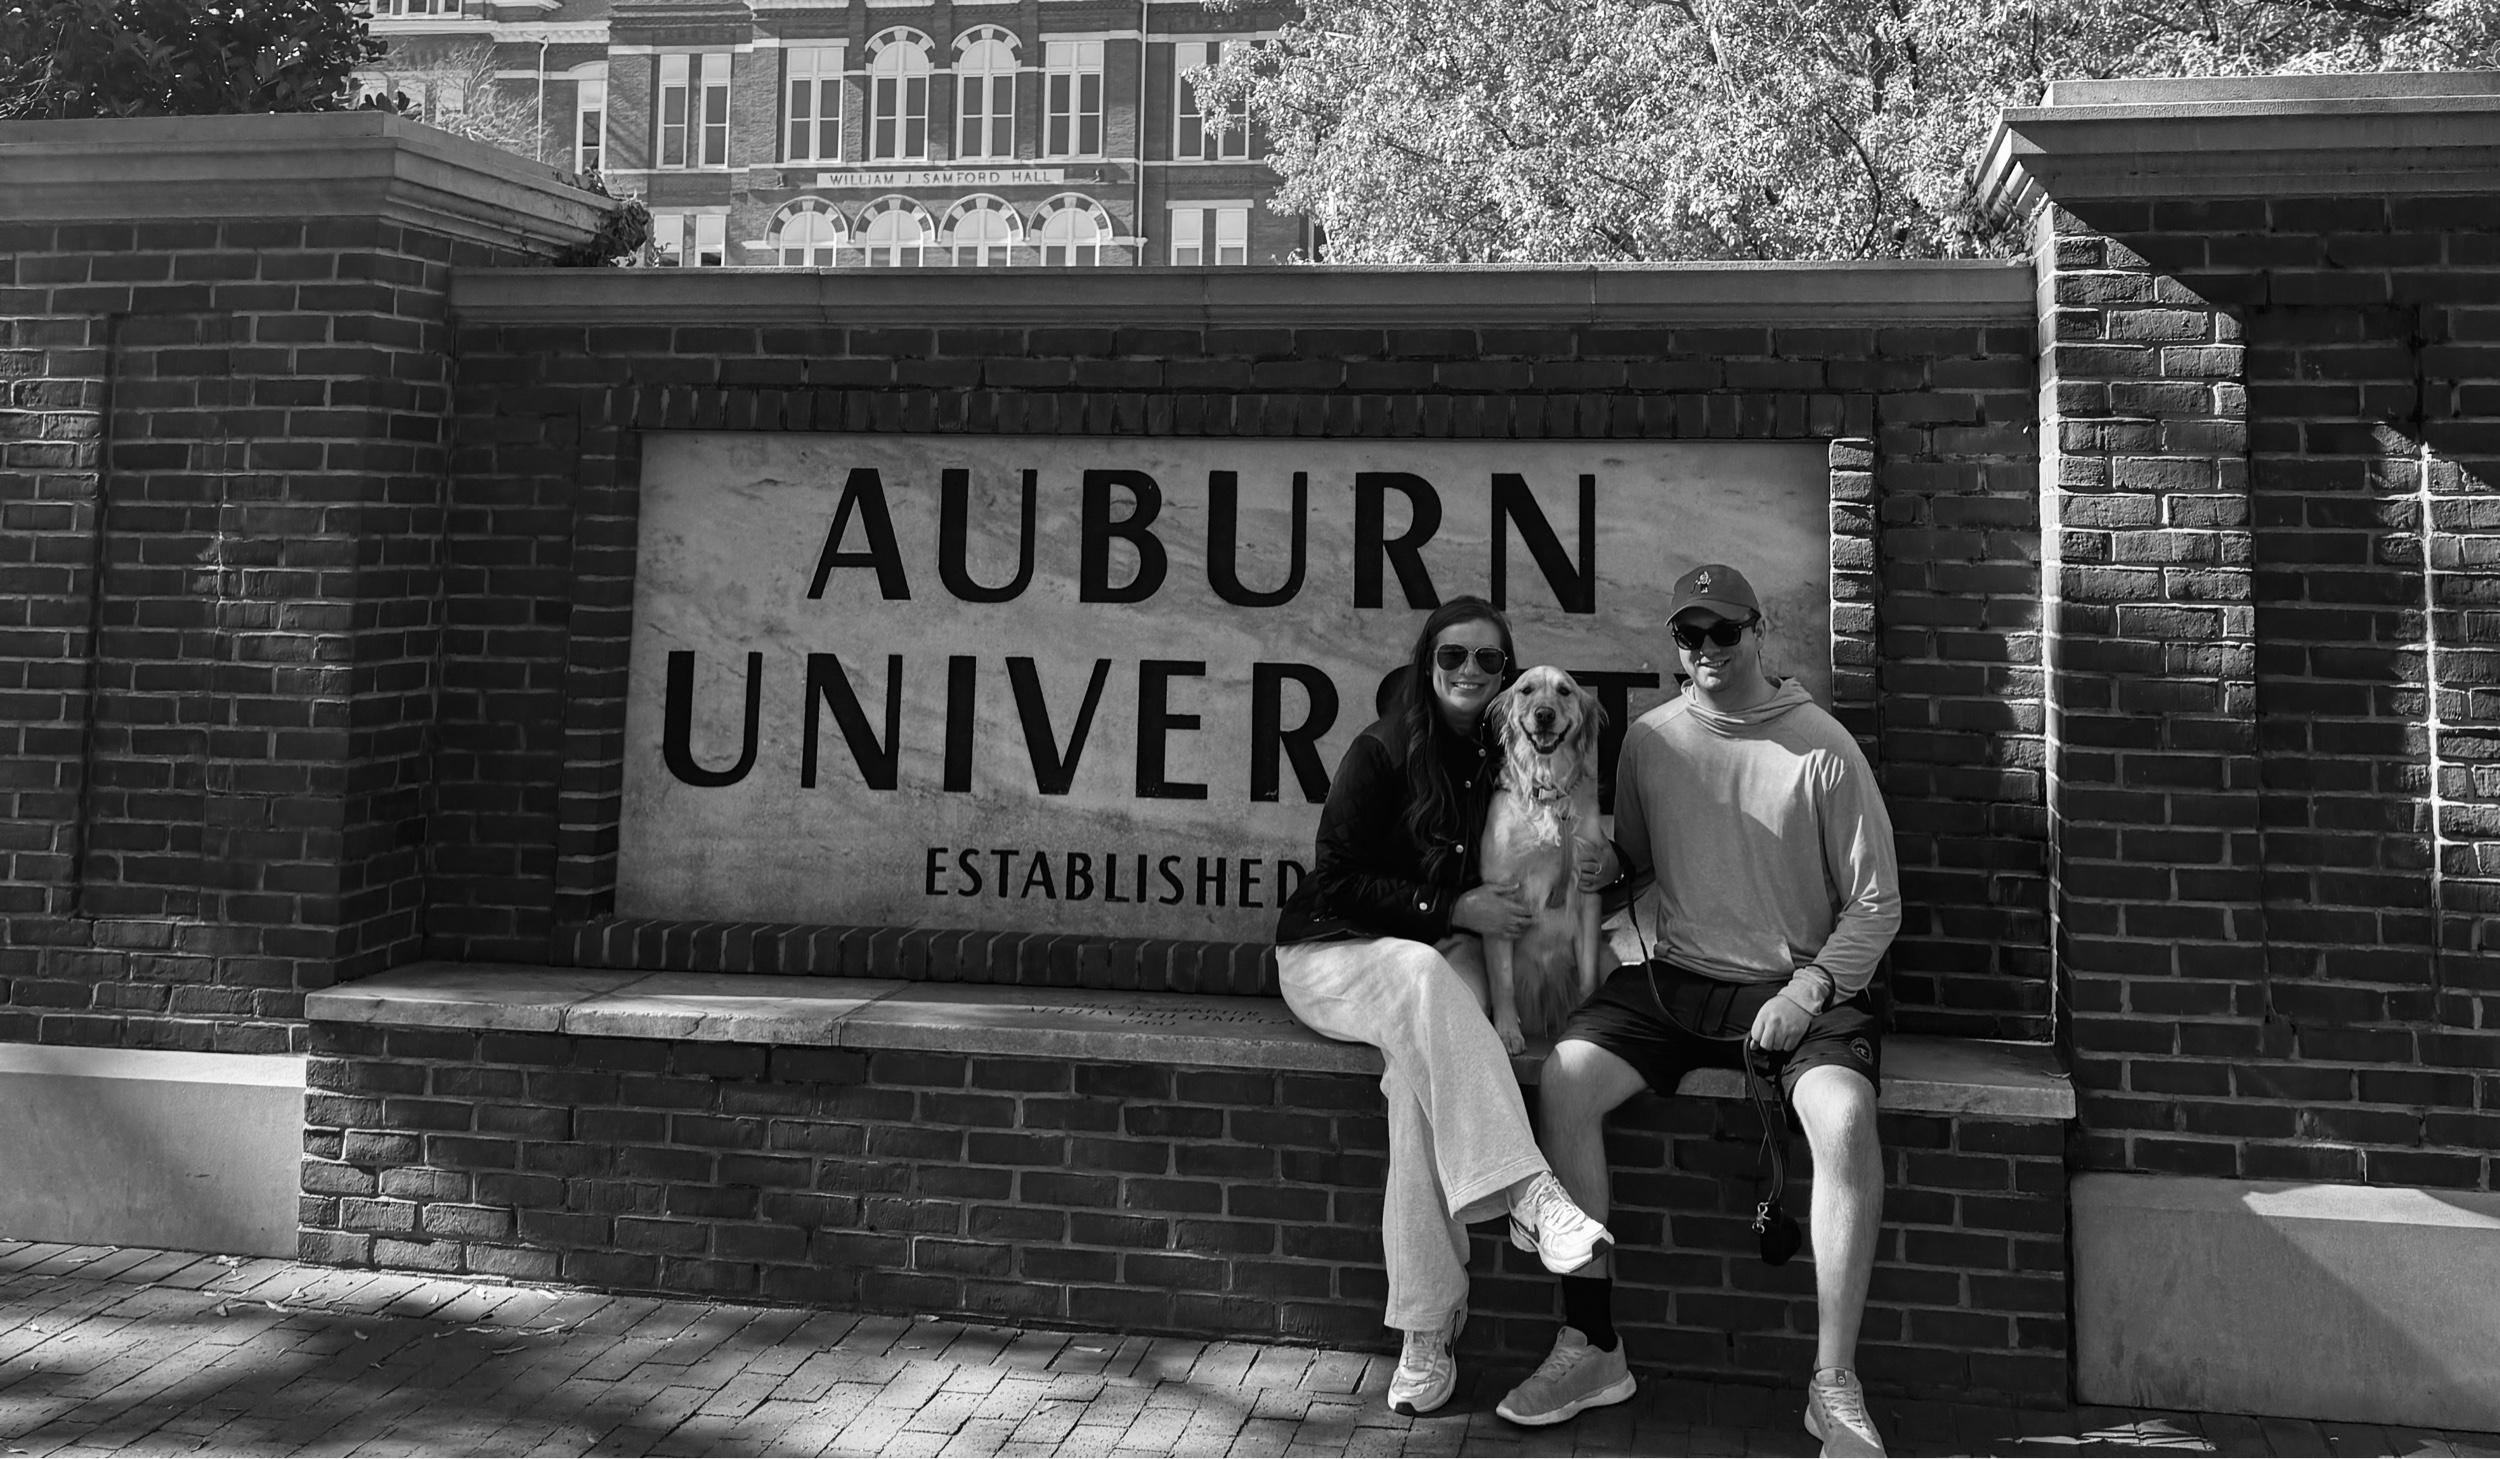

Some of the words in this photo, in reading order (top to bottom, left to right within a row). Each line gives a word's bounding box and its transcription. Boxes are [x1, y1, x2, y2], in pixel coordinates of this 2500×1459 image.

[830, 174, 894, 186] WILLIAM
[922, 171, 1000, 184] SAMFORD
[1011, 170, 1052, 182] HALL
[807, 467, 1596, 614] AUBURN
[662, 650, 1794, 816] UNIVERT
[925, 847, 1307, 909] ESTABLISHED
